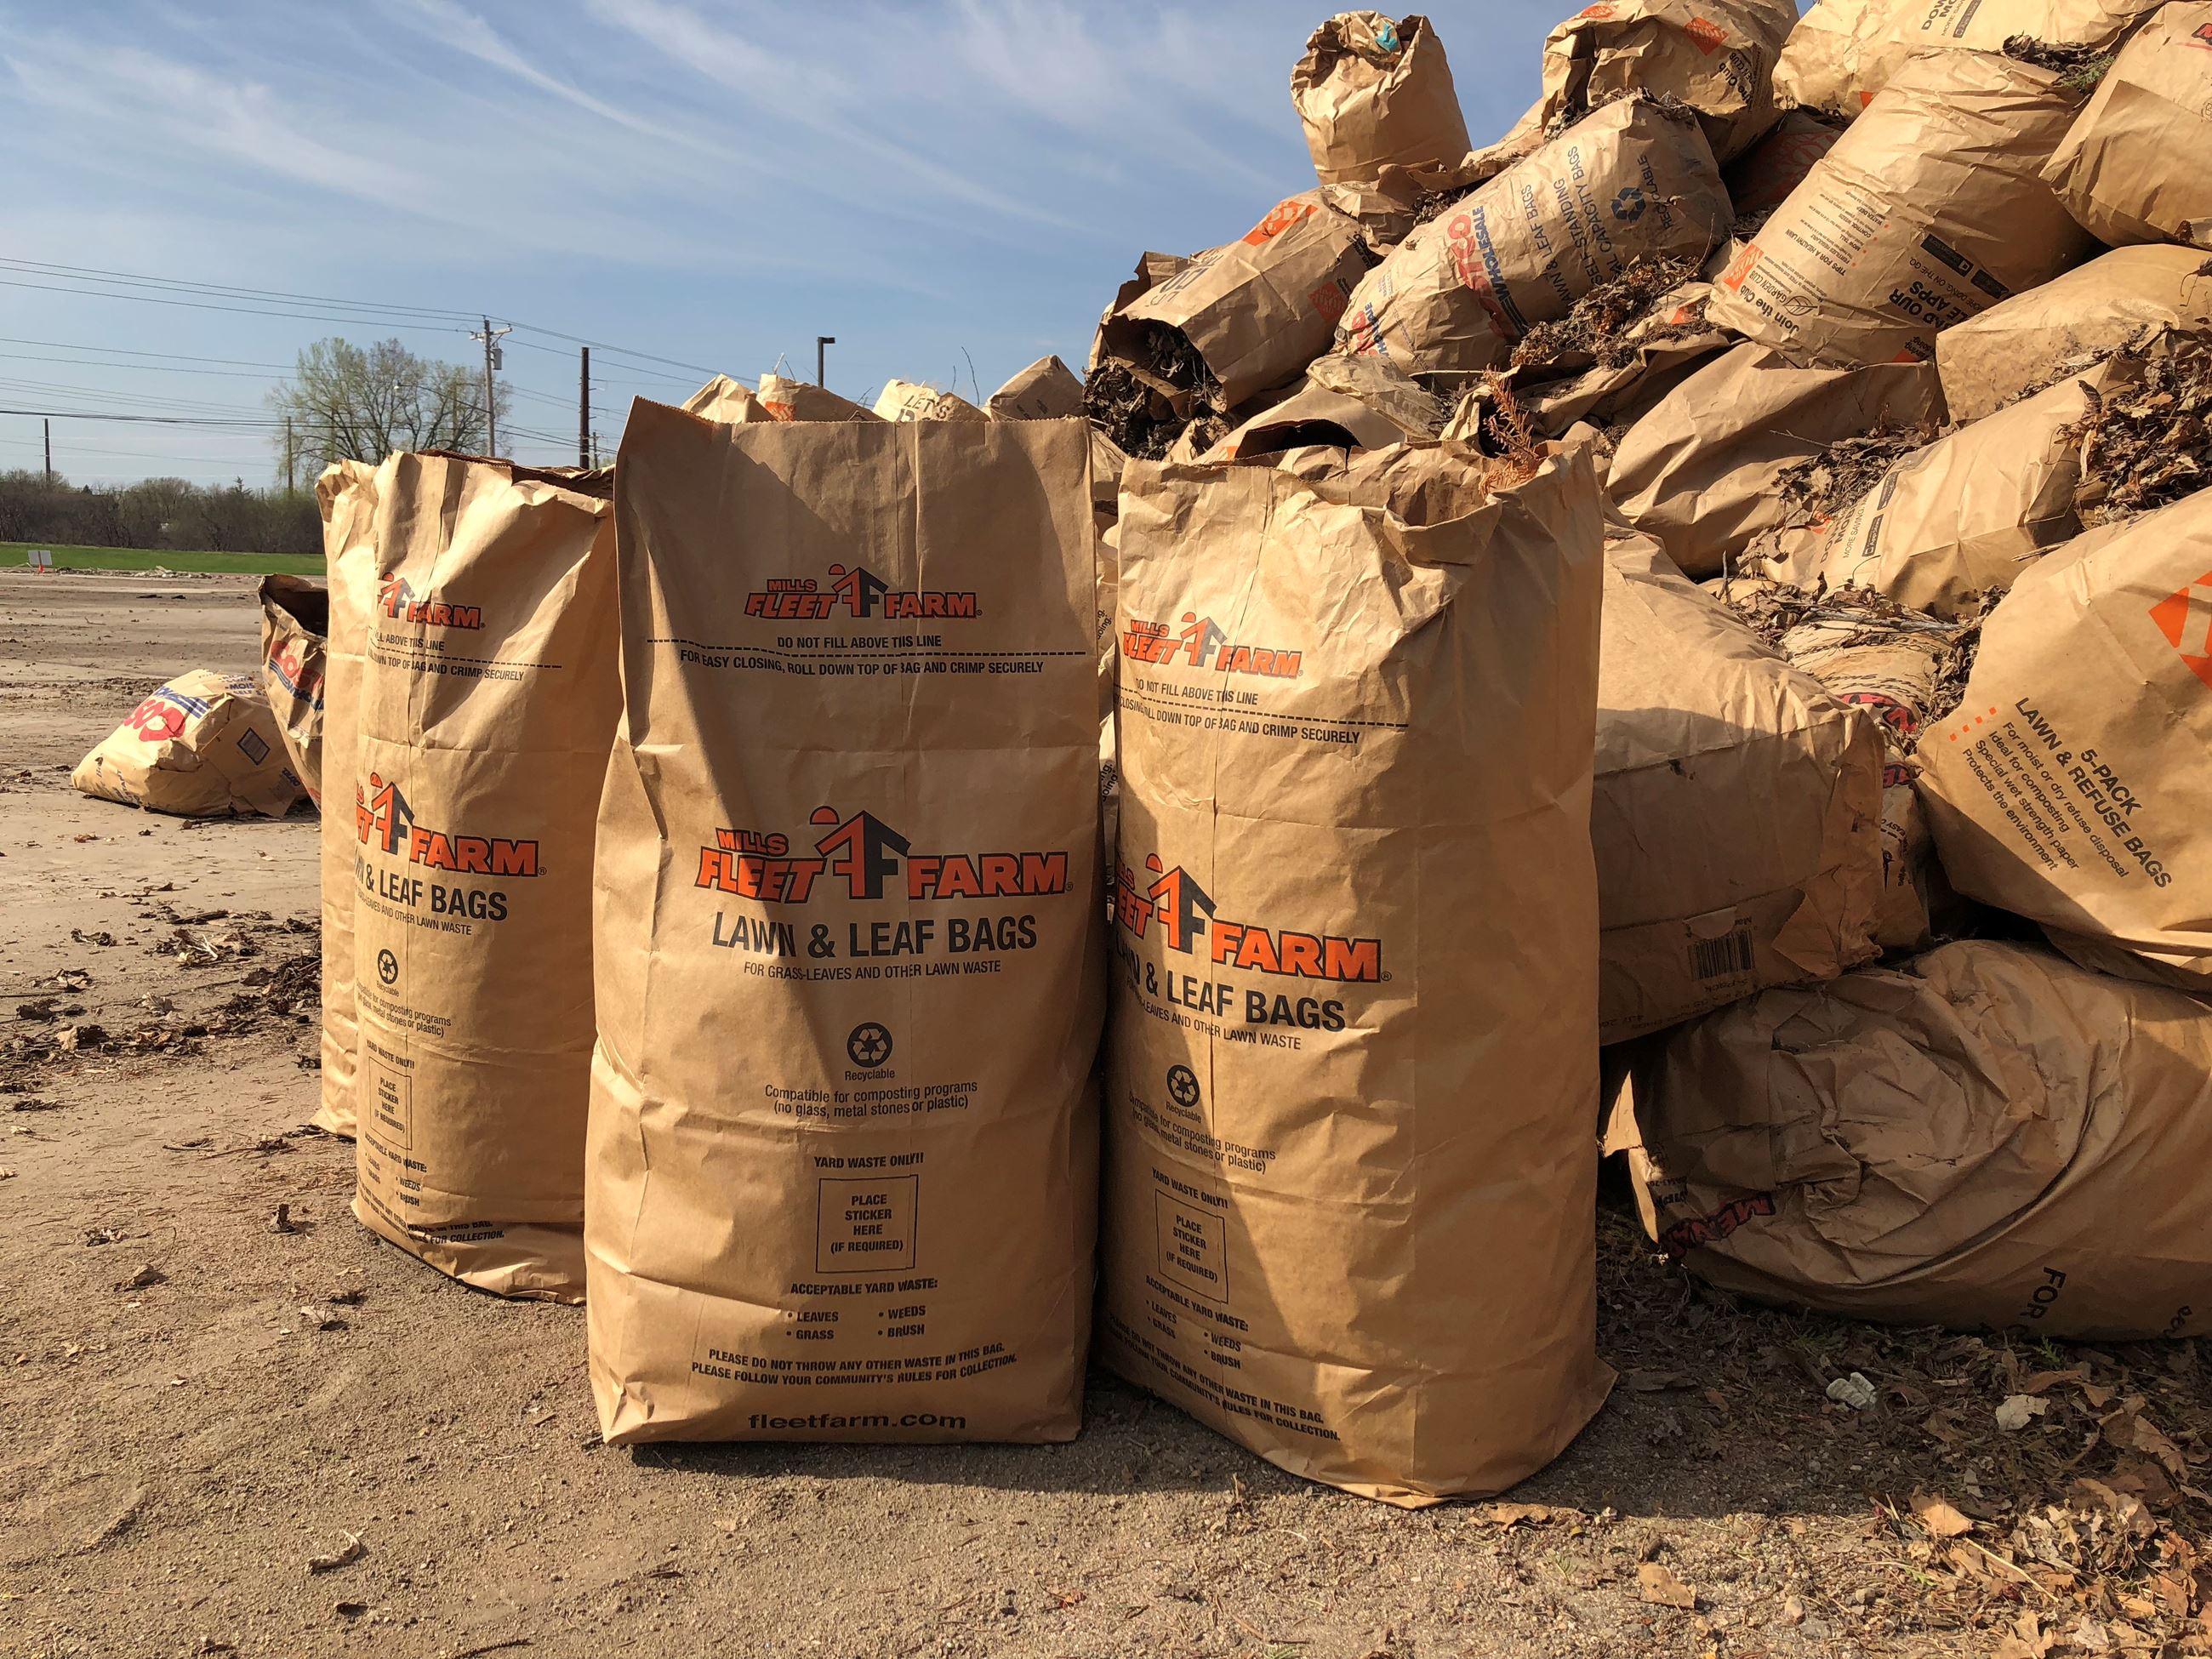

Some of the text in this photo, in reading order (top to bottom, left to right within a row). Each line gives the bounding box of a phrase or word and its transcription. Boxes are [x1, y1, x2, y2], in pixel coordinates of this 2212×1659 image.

[1568, 145, 1612, 253] CAPACITY BAGS
[1521, 184, 1553, 259] LEAF BAGS
[1473, 205, 1510, 300] WHOLESALE
[1748, 270, 1763, 287] CLUB
[1829, 263, 1846, 276] TIPS
[1920, 266, 1936, 280] THE
[1760, 279, 1787, 304] GARDEN
[1889, 288, 1923, 316] OUR
[1909, 281, 1950, 311] APPS
[1741, 285, 1800, 334] Join the Club
[904, 395, 950, 420] LET'S
[767, 578, 817, 593] MILLS
[407, 601, 481, 630] FARM
[744, 591, 976, 619] FLEET FARM
[1131, 619, 1170, 636] MILLS
[425, 641, 445, 652] LINE
[778, 636, 942, 648] DO NOT FILL ABOVE LINE
[681, 649, 1044, 676] FOR EASY CLOSING, ROLL DOWN TOP OF AND CRIMP SECURELY
[1123, 631, 1303, 678] FLEET FARM
[450, 664, 524, 681] CRIMP SECURELY
[1182, 687, 1258, 706] ABOVE LINE
[1238, 721, 1360, 744] AND CRIMP SECURELY
[1988, 731, 2070, 833] Ideal for composting
[2015, 697, 2172, 888] LAWN & REFUSE BAGS
[2081, 749, 2142, 816] 5-PACK
[1963, 748, 2058, 871] Protects the environment
[1975, 739, 2079, 870] Special wet strength paper
[2003, 721, 2129, 878] For moist or dry refuse disposal
[409, 825, 539, 877] FARM
[715, 827, 789, 856] MILLS
[694, 846, 1069, 904] FLEET FARM
[366, 864, 508, 921] & LEAF BAGS
[711, 911, 1037, 958] LAWN & LEAF BAGS
[1211, 918, 1382, 983] FARM
[744, 960, 1001, 981] FOR GRASS-LEAVES AND OTHER LAWN WASTE
[1167, 970, 1346, 1032] LEAF BAGS
[1223, 1027, 1302, 1051] LAWN WASTE
[844, 1068, 895, 1082] Recyclable
[765, 1080, 978, 1104] Compatible for composting programs
[773, 1094, 969, 1119] (no glass, metal stones or plastic)
[814, 1152, 924, 1168] YARD WASTE ONLY!!
[1224, 1140, 1276, 1160] programs
[1228, 1154, 1267, 1175] plastic)
[852, 1194, 887, 1206] PLACE
[1171, 1180, 1199, 1199] WASTE
[845, 1208, 892, 1221] STICKER
[1176, 1215, 1202, 1234] PLACE
[853, 1224, 883, 1235] HERE
[1172, 1227, 1207, 1250] STICKER
[830, 1240, 904, 1255] (IF REQUIRED)
[1179, 1242, 1200, 1260] HERE
[790, 1278, 938, 1295] ACCEPTABLE YARD WASTE:
[2020, 1266, 2067, 1320] FOR
[797, 1311, 839, 1322] LEAVES
[888, 1305, 926, 1320] WEEDS
[1215, 1312, 1249, 1331] WASTE:
[795, 1330, 834, 1340] GRASS
[887, 1325, 925, 1337] BRUSH
[709, 1343, 1005, 1371] PLEASE DO NOT THROW ANY OTHER WASTE IN THIS BAG.
[692, 1354, 1018, 1386] PLEASE FOLLOW YOUR COMMUNITY'S RULES FOR COLLECTION.
[1225, 1388, 1324, 1424] WASTE THIS BAG.
[749, 1413, 966, 1431] fleetfarm.com
[1276, 1416, 1341, 1441] COLLECTION.
